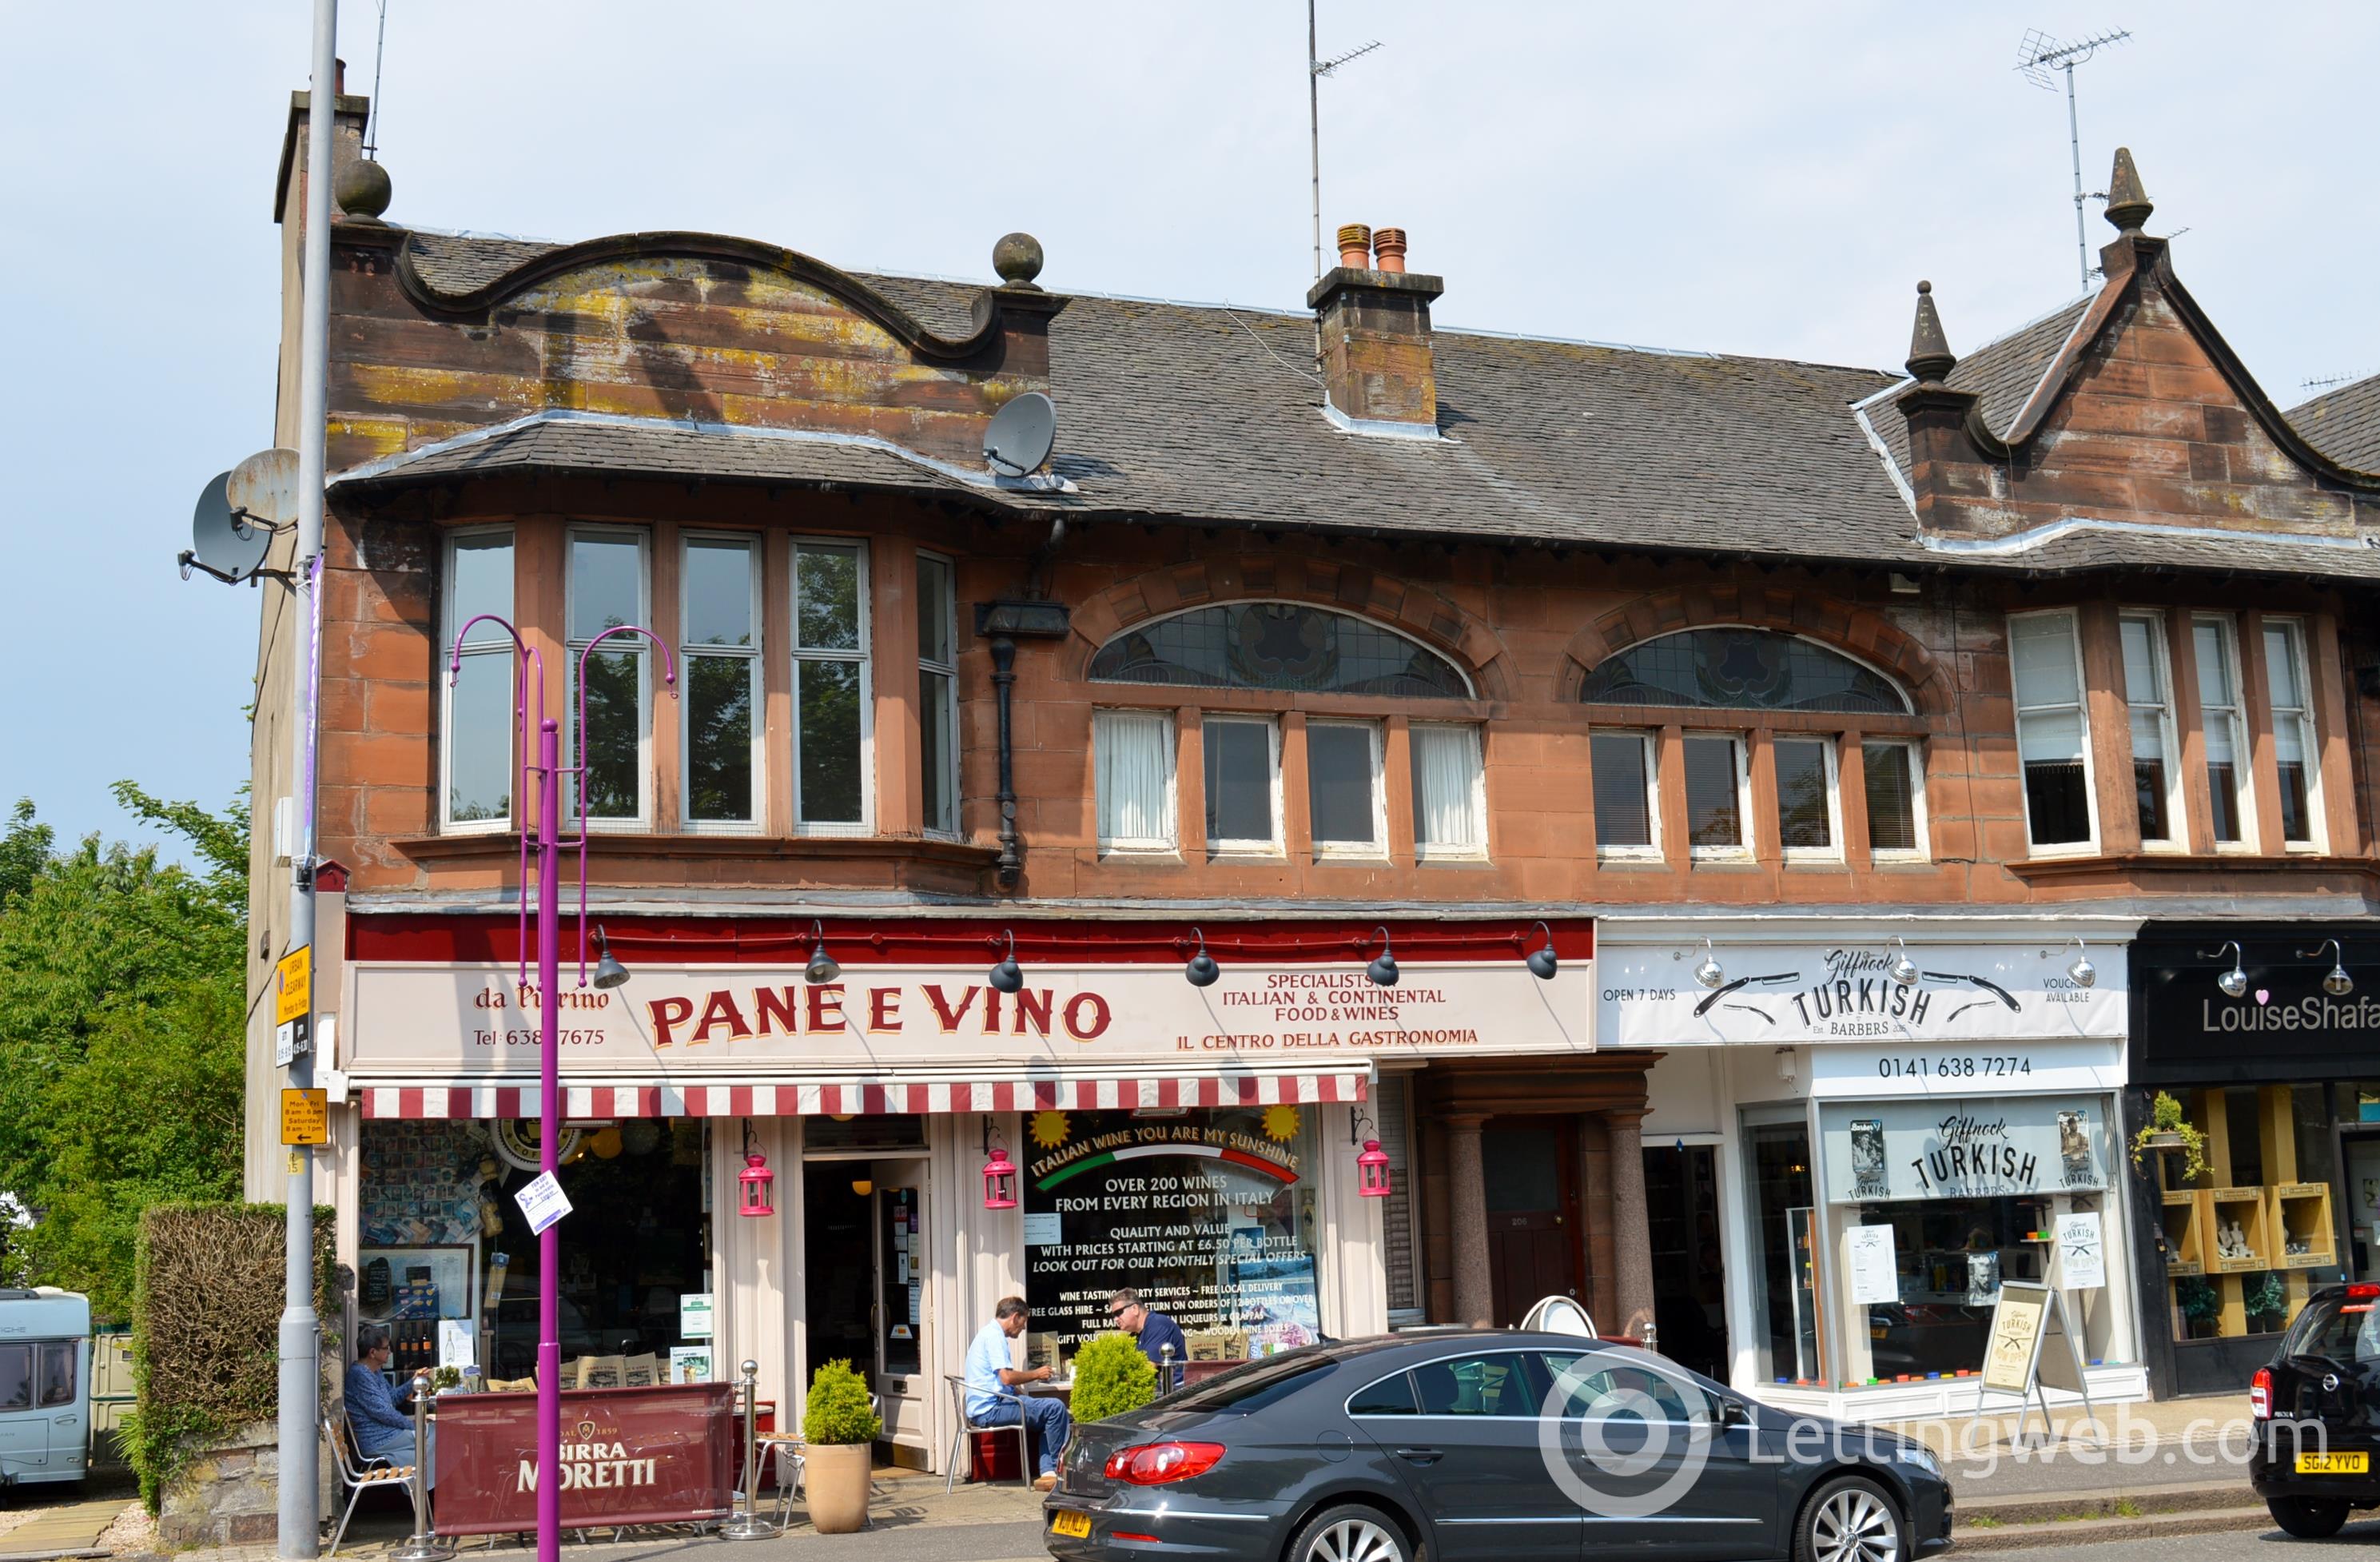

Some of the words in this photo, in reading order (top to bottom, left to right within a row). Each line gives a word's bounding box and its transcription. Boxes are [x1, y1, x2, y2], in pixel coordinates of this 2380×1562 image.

[289, 956, 303, 974] URBAN
[1824, 949, 1894, 985] Giffnock
[285, 975, 306, 996] CLEARWAY
[1267, 974, 1375, 989] SPECIALISTS
[474, 986, 507, 1010] da
[517, 984, 609, 1010] Pirino
[1223, 990, 1295, 1006] ITALIAN
[1307, 991, 1319, 1005] &
[1327, 989, 1447, 1004] CONTINENTAL
[1603, 989, 1634, 1002] OPEN
[1638, 989, 1645, 1001] 7
[1650, 989, 1676, 1001] DAYS
[1791, 978, 1932, 1030] TURKISH
[2046, 992, 2090, 1002] AVAILABLE
[647, 983, 846, 1050] PANE
[867, 986, 904, 1035] E
[920, 984, 1112, 1042] VINO
[1276, 1007, 1327, 1022] FOOD
[1331, 1007, 1341, 1021] &
[1343, 1006, 1399, 1020] WINES
[506, 1030, 542, 1046] 638
[559, 1030, 605, 1046] 7675
[1830, 1022, 1888, 1036] BARBERS
[1176, 1036, 1195, 1050] IL
[1202, 1034, 1275, 1050] CENTRO
[1283, 1032, 1339, 1049] DELLA
[1349, 1028, 1479, 1046] GASTRONOMIA
[1879, 1058, 1928, 1078] 0141
[1938, 1058, 1975, 1077] 638
[1982, 1057, 2031, 1076] 7274
[1938, 1115, 2009, 1151] Giffnock
[1030, 1140, 1090, 1177] ITALIAN
[1092, 1129, 1132, 1149] WINE
[1133, 1126, 1168, 1142] YOU
[1172, 1126, 1199, 1141] ARE
[1204, 1127, 1226, 1144] MY
[1229, 1132, 1300, 1170] SUNSHINE
[1911, 1143, 2036, 1189] TURKISH
[1104, 1177, 1148, 1193] OVER
[1150, 1177, 1178, 1191] 200
[1182, 1175, 1228, 1190] WINES
[2059, 1173, 2099, 1189] TURKISH
[1848, 1185, 1892, 1201] TURKISH
[1950, 1185, 2006, 1198] BARBERS
[1056, 1197, 1099, 1213] FROM
[1104, 1196, 1148, 1211] EVERY
[1152, 1193, 1209, 1209] REGION
[1216, 1193, 1230, 1206] IN
[1234, 1191, 1275, 1205] ITALY
[1511, 1217, 1527, 1226] 206
[1110, 1226, 1160, 1241] QUALITY
[1164, 1225, 1191, 1237] AND
[1193, 1223, 1231, 1236] VALUE
[2063, 1228, 2095, 1241] TURKISH
[1041, 1245, 1072, 1257] WITH
[1076, 1243, 1115, 1256] PRICES
[1118, 1241, 1175, 1254] STARTING
[1178, 1240, 1194, 1252] AT
[1197, 1238, 1230, 1251] £6.50
[1233, 1237, 1253, 1249] PER
[1256, 1236, 1298, 1249] BOTTLE
[1033, 1259, 1068, 1273] LOOK
[1072, 1258, 1097, 1272] OUT
[1100, 1257, 1125, 1270] FOR
[1128, 1256, 1155, 1269] OUR
[1157, 1253, 1216, 1268] MONTHLY
[1218, 1252, 1262, 1265] SPECIAL
[1265, 1249, 1307, 1263] OFFERS
[1060, 1291, 1081, 1301] WINE
[1155, 1286, 1191, 1297] SERVICES
[1201, 1285, 1219, 1295] FREE
[1220, 1283, 1247, 1293] LOCAL
[1249, 1282, 1284, 1293] DELIVERY
[1048, 1305, 1073, 1317] GLASS
[1075, 1305, 1094, 1315] HIRE
[1144, 1301, 1171, 1312] ETURN
[1172, 1301, 1186, 1311] ON
[1188, 1299, 1218, 1310] ORDERS
[1220, 1298, 1231, 1309] OF
[1234, 1297, 1242, 1307] 12
[1244, 1295, 1279, 1307] BOTTLES
[1280, 1295, 1291, 1305] OR
[1292, 1294, 1314, 1305] OVER
[1082, 1319, 1101, 1329] FULL
[1180, 1312, 1218, 1325] LIQUEURS
[1220, 1313, 1228, 1322] &
[1229, 1311, 1264, 1322] GRAPPAS
[2002, 1318, 2032, 1333] TURKISH
[1057, 1334, 1075, 1345] GIFT
[1203, 1327, 1240, 1337] WOODEN
[1241, 1325, 1262, 1335] WINE
[1264, 1323, 1290, 1333] BOXES
[596, 1427, 618, 1436] 1859
[560, 1441, 627, 1460] BIRRA
[2304, 1455, 2331, 1470] SG12
[2334, 1455, 2360, 1470] YVO
